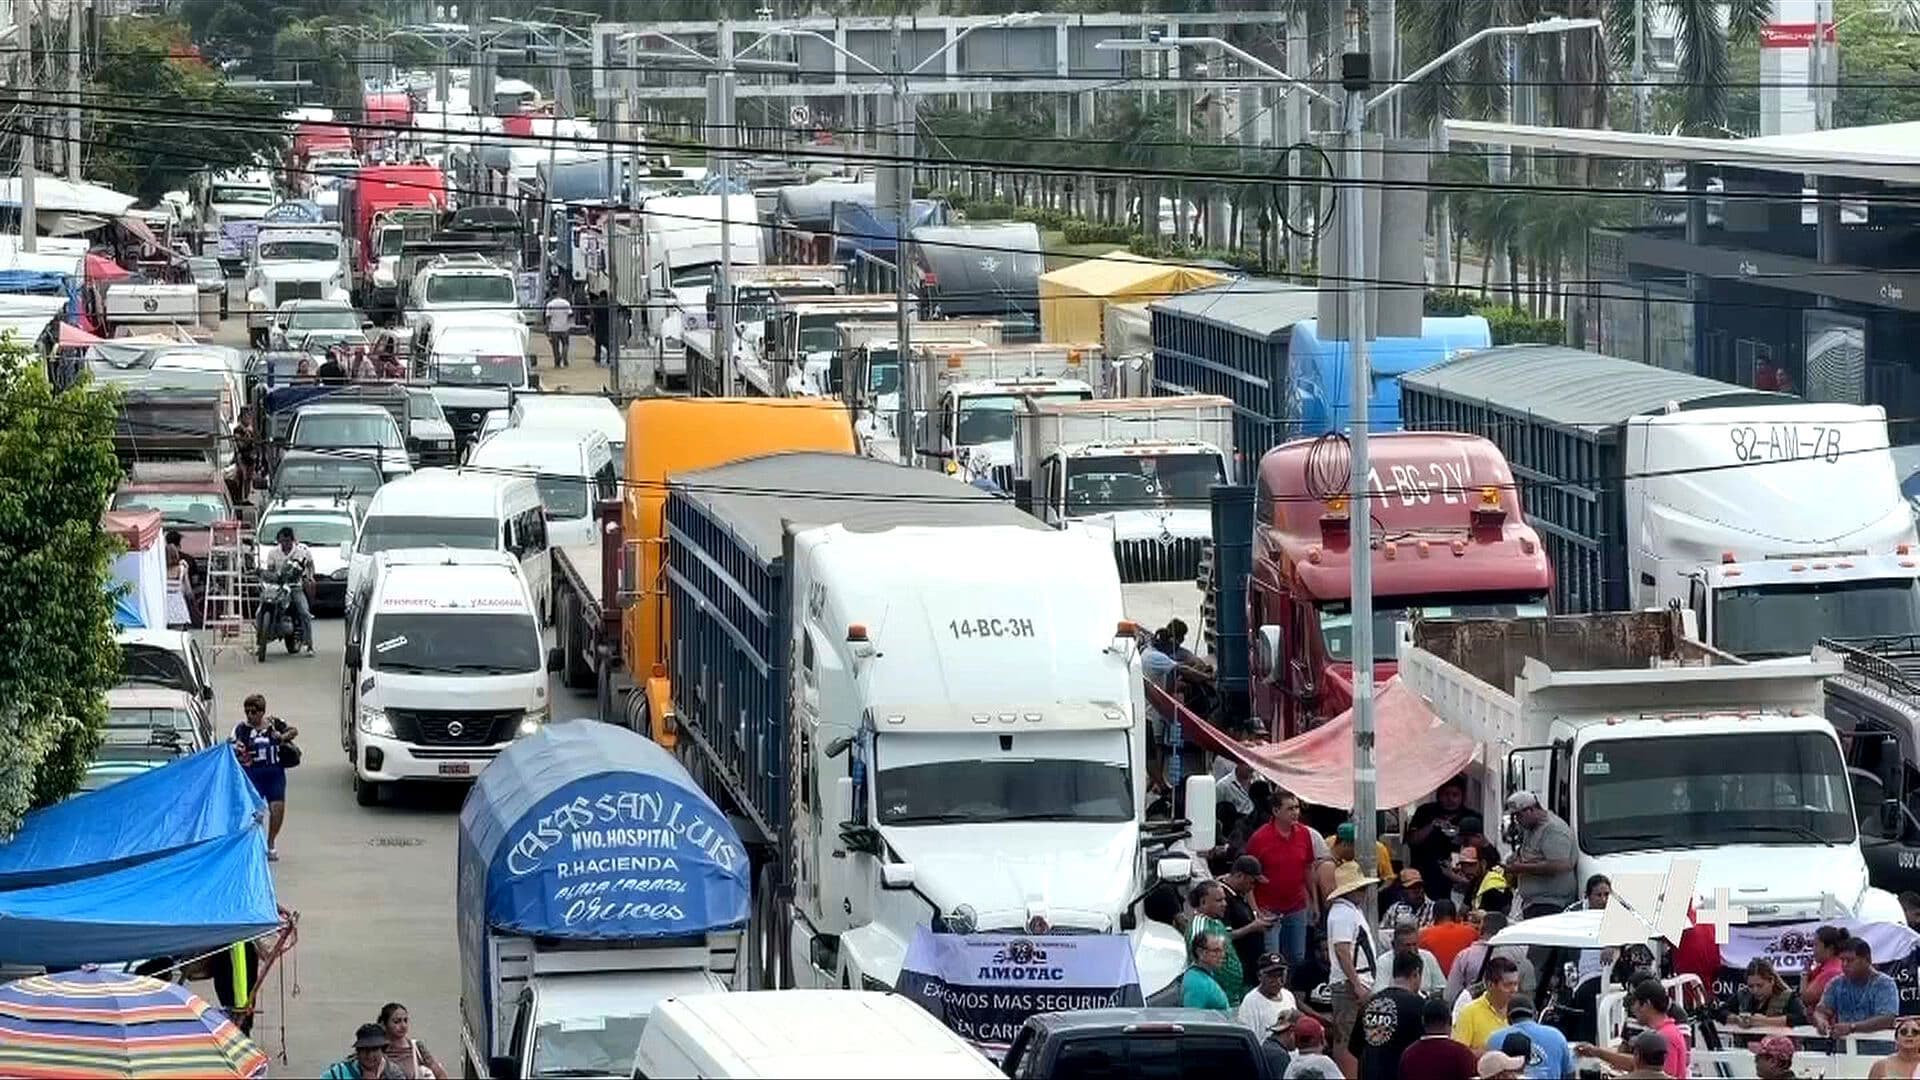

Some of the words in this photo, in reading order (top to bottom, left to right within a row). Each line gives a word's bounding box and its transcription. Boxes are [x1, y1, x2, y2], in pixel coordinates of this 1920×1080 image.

[1730, 426, 1841, 464] 82-AM-7B
[1367, 463, 1467, 508] 1-BG-2Y
[949, 618, 1035, 639] 14-BC-3H
[507, 796, 595, 875] CASAS
[595, 791, 663, 823] SAN
[667, 802, 737, 871] LUIS
[978, 966, 1064, 981] AMOTAC
[993, 994, 1032, 1010] MAS
[1036, 992, 1119, 1010] SEGURIDA
